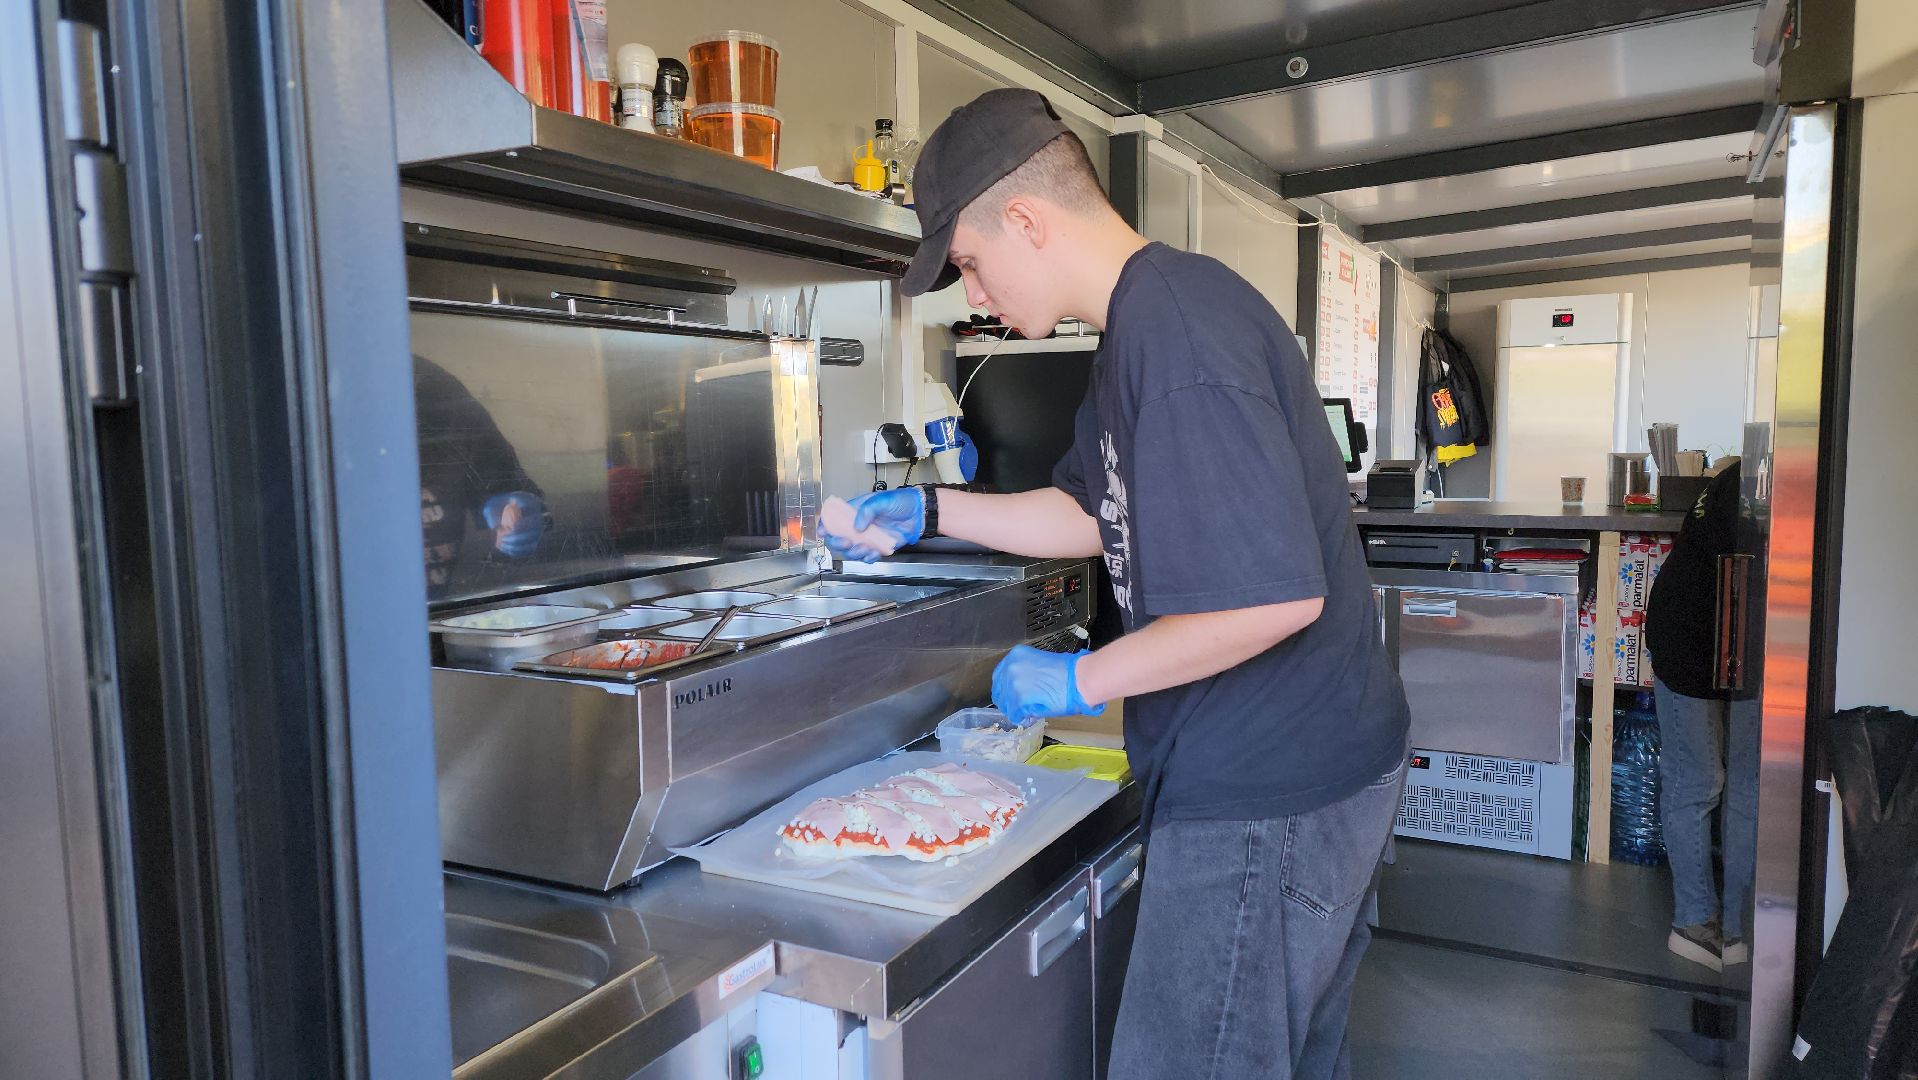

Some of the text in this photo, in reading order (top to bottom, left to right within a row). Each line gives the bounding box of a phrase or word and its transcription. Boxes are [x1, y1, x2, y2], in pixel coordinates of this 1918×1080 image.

[1633, 559, 1645, 607] parmalat
[1625, 633, 1637, 682] parmalat
[675, 678, 732, 709] POLAIR
